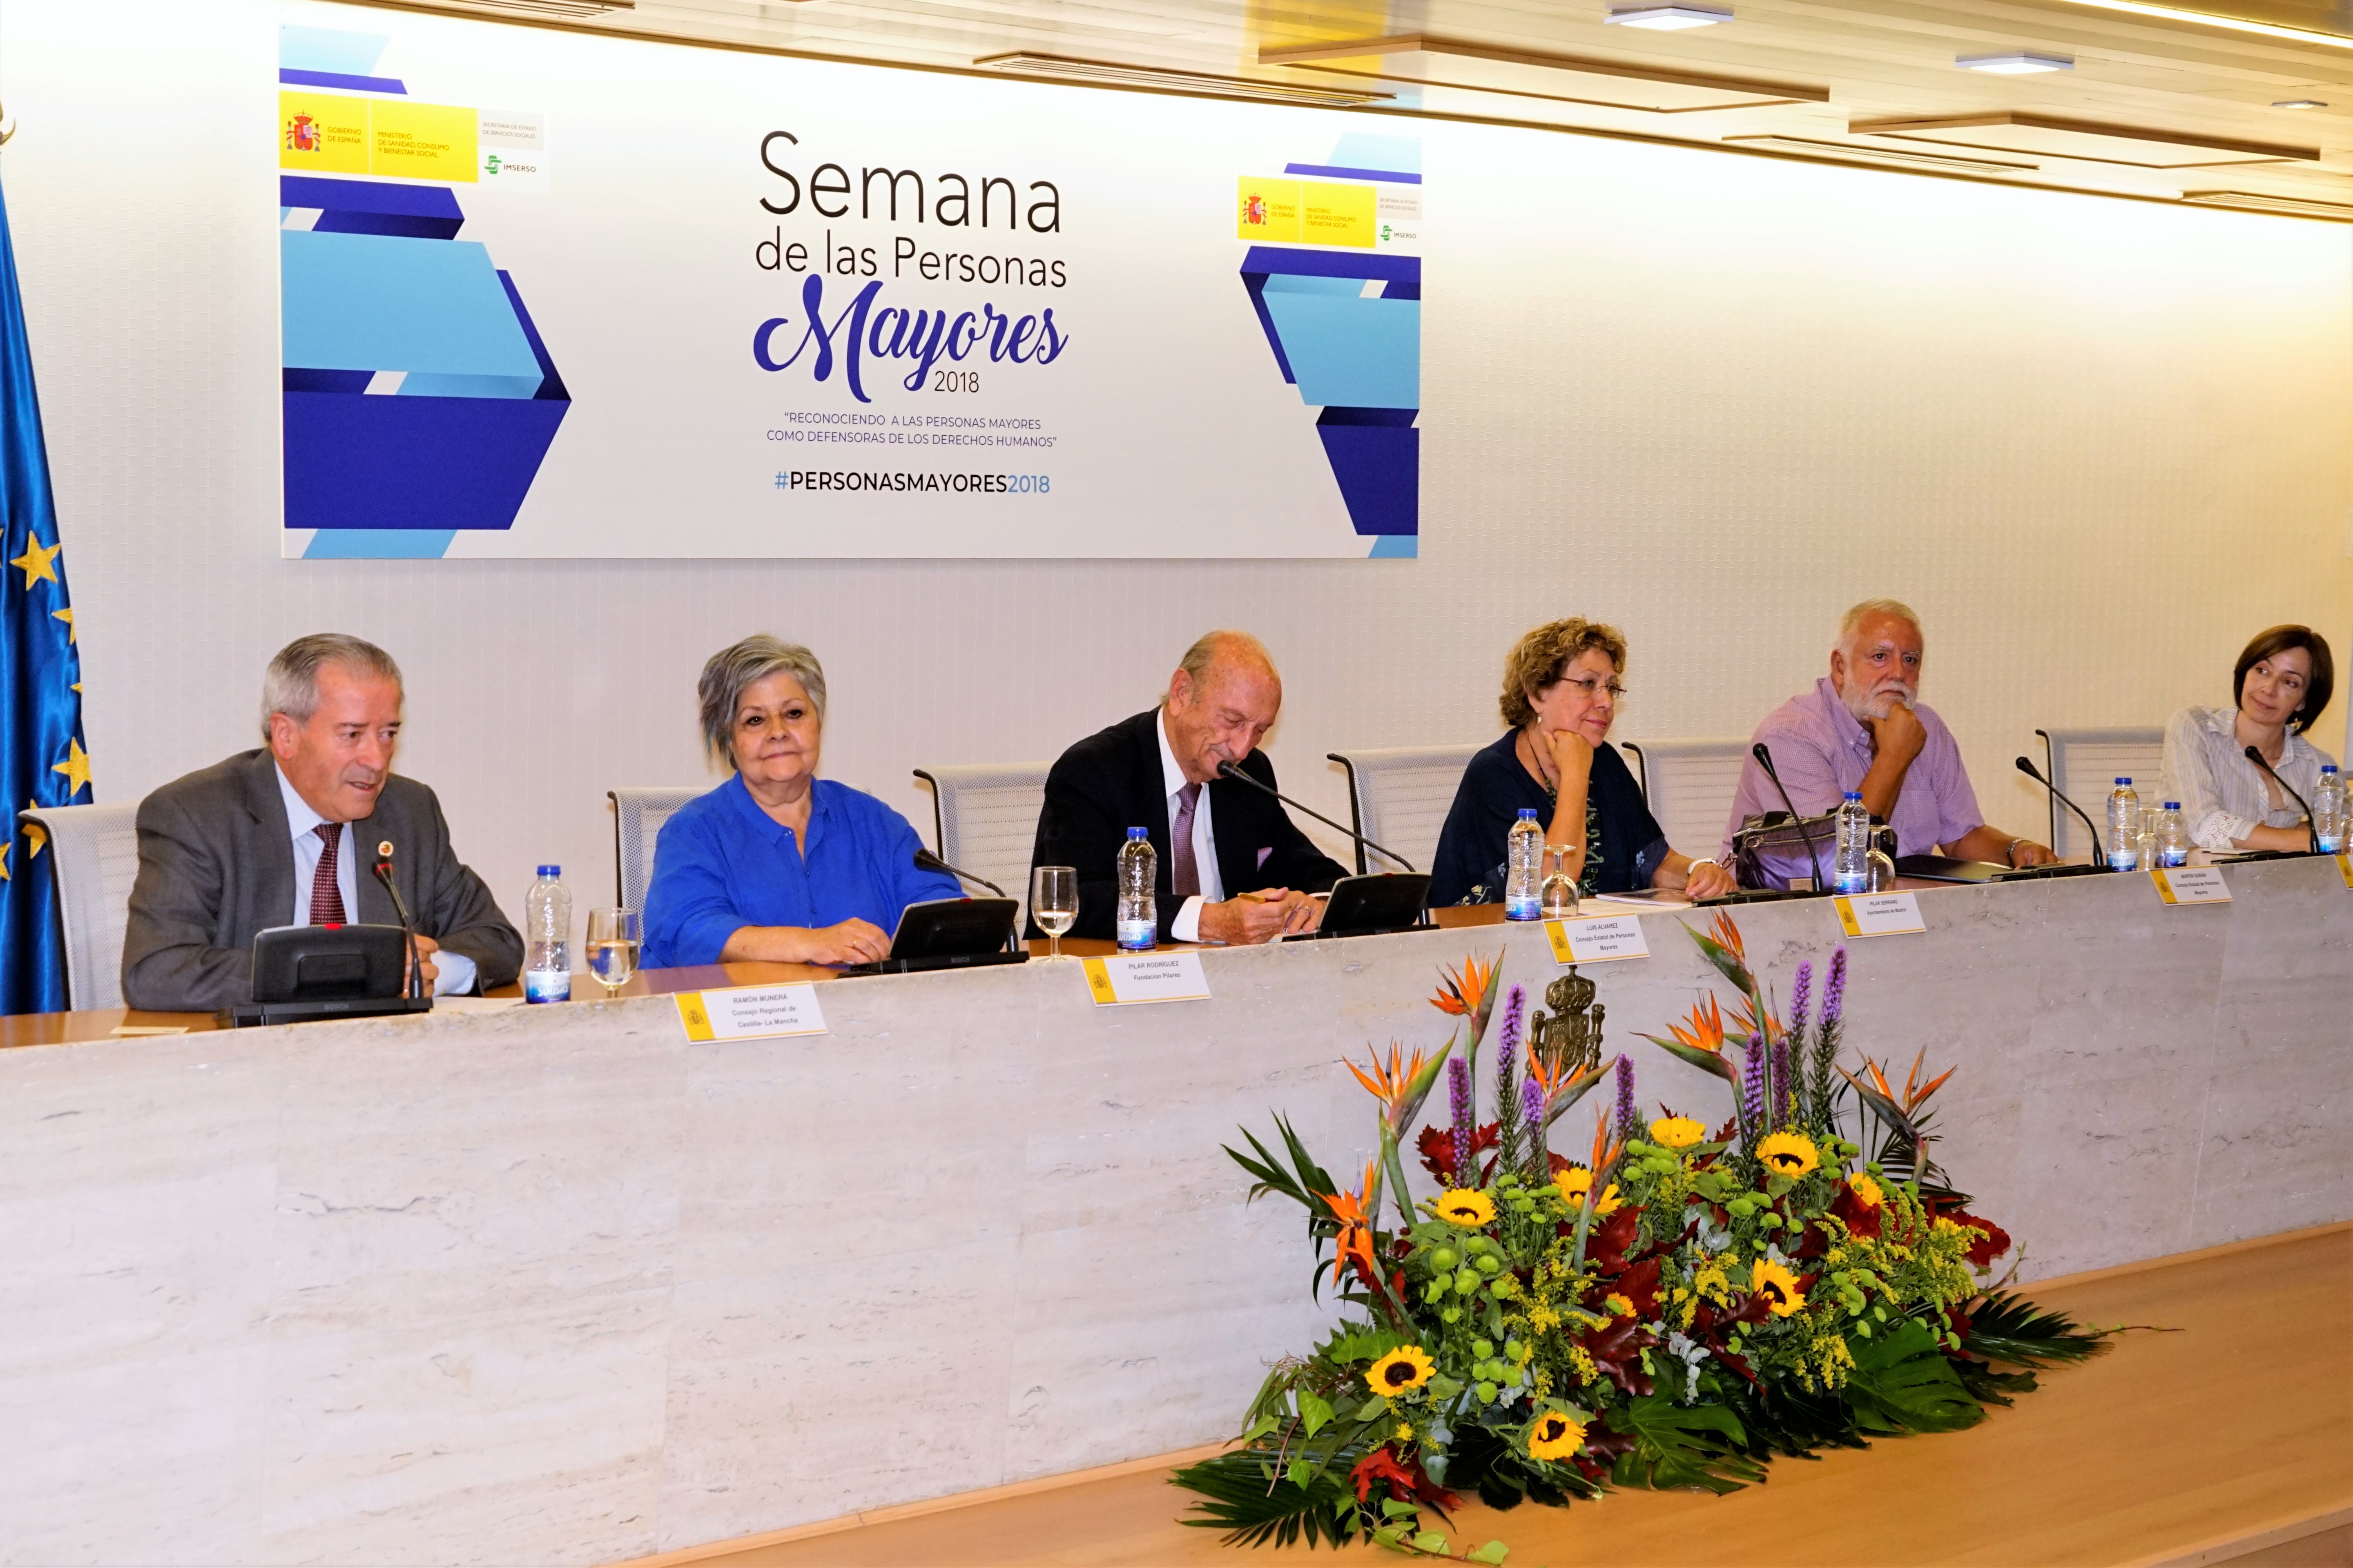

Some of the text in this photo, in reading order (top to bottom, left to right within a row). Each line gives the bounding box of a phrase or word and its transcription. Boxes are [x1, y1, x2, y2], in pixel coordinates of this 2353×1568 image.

[327, 127, 361, 135] GOBIERNO
[388, 140, 416, 149] SANIDAD,
[504, 164, 536, 172] IMSERSO
[759, 130, 1061, 233] Semana
[755, 225, 1067, 288] de las Personas
[753, 274, 1069, 403] Mayores
[934, 370, 979, 393] 2018
[891, 416, 900, 426] A
[903, 416, 923, 427] LAS
[926, 416, 986, 428] PERSONAS
[989, 418, 1041, 430] MAYORES
[767, 430, 804, 442] COMO
[808, 431, 885, 443] DEFENSORAS
[889, 433, 904, 443] DE
[908, 434, 929, 444] LOS
[932, 434, 993, 446] DERECHOS
[775, 471, 1050, 493] #PERSONASMAYORES2018
[760, 1006, 787, 1014] Regional
